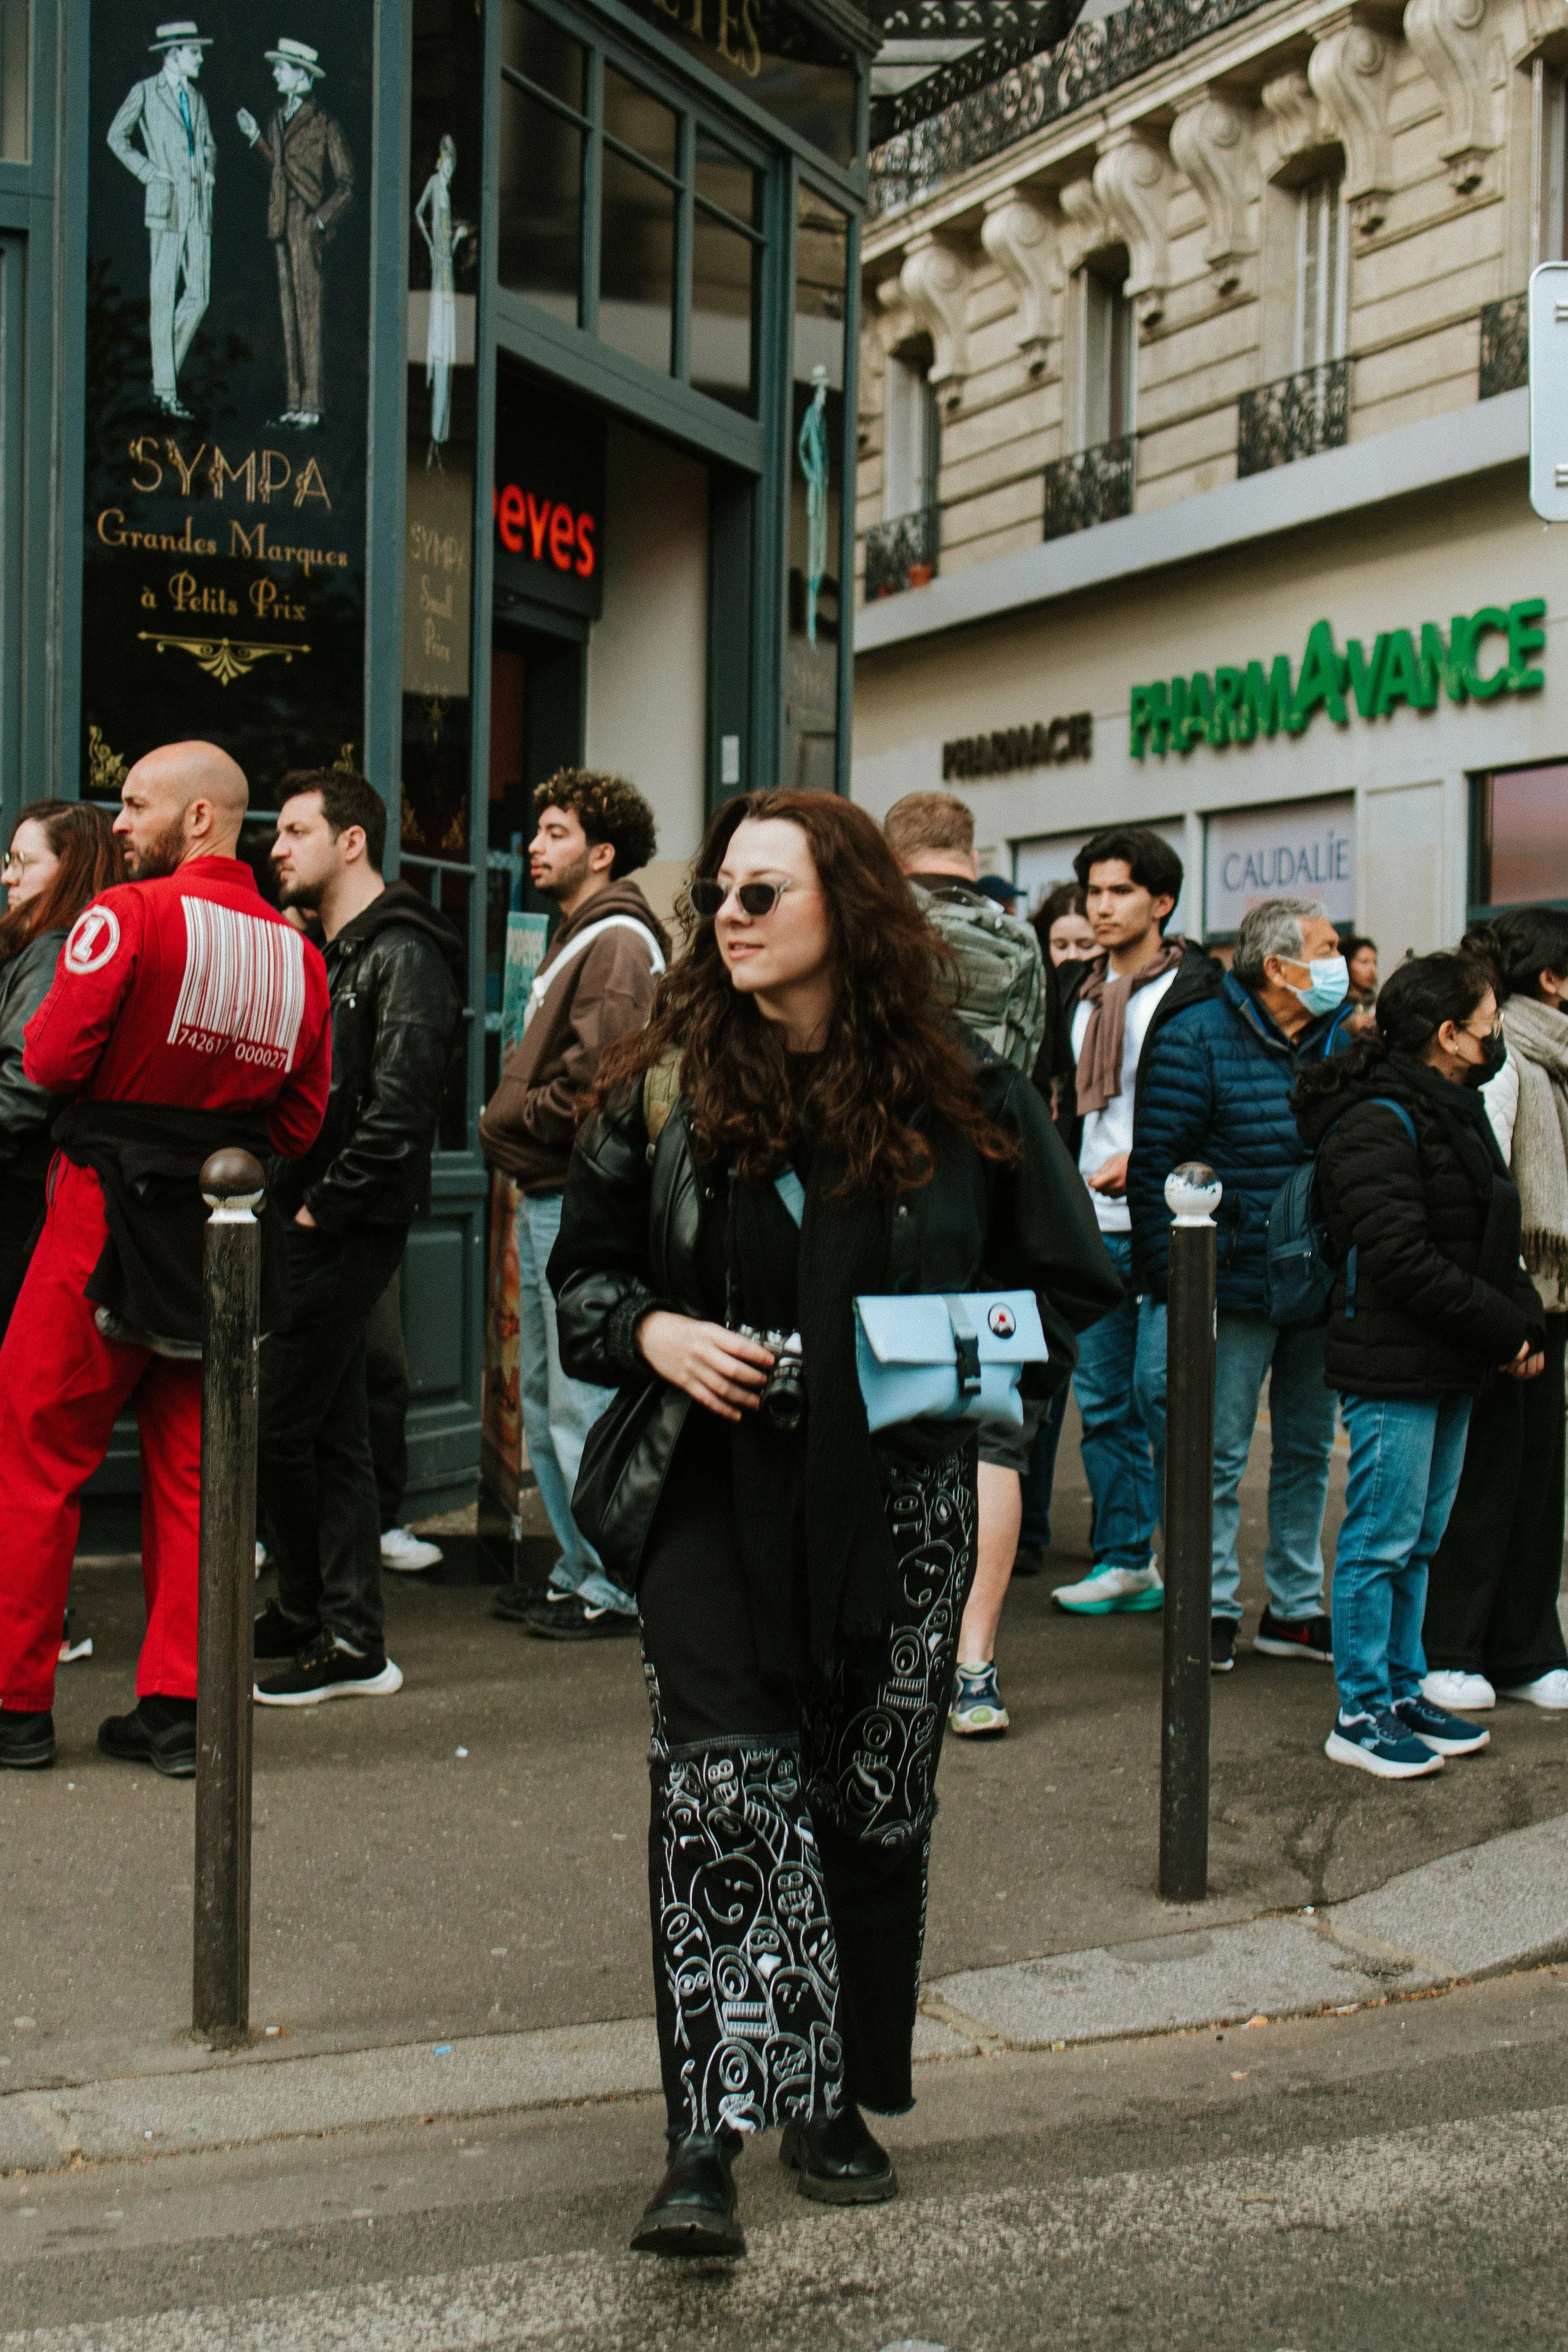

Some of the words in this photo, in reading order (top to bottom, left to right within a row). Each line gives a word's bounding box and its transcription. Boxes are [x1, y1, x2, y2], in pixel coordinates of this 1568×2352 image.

[129, 437, 332, 511] SYMPA
[97, 508, 217, 556] Grandes
[229, 519, 349, 578] Marques
[492, 482, 596, 579] eyes
[140, 585, 157, 609] à
[167, 569, 238, 616] Petits
[248, 576, 307, 622] Prix
[1130, 597, 1548, 759] PHARMAVANCE
[178, 1027, 230, 1054] 742617
[235, 1042, 287, 1070] 000027
